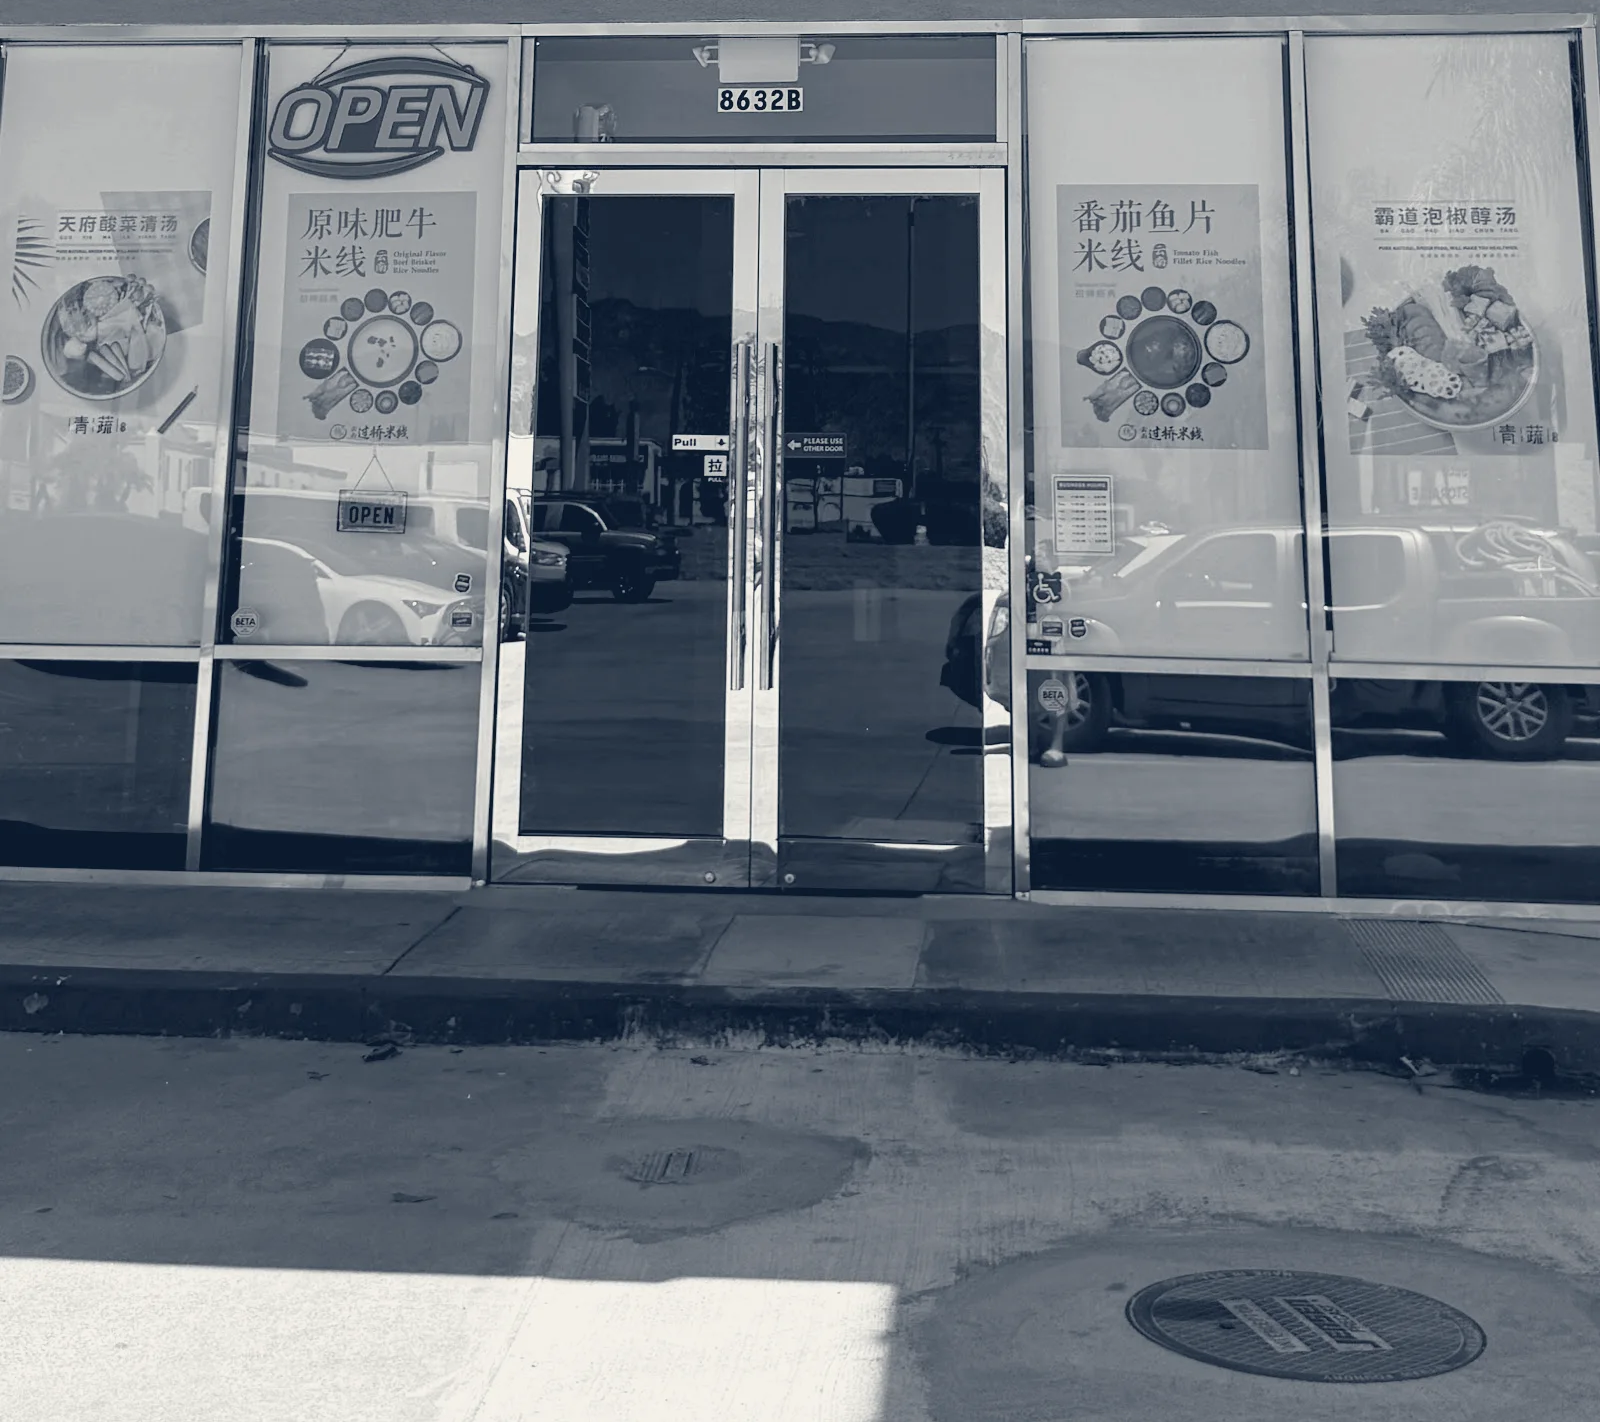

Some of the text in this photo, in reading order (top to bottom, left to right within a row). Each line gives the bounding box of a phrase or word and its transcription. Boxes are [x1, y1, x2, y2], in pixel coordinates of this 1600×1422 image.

[719, 89, 801, 111] 8632B
[269, 85, 488, 155] OPEN
[58, 215, 178, 233] 天府酸菜清汤
[300, 207, 437, 240] 原味肥牛
[1072, 199, 1216, 234] 番茄鱼片
[1374, 207, 1517, 226] 霸道泡椒醇汤
[298, 245, 367, 278] 米线
[393, 250, 423, 259] Original
[1072, 238, 1145, 273] 米线
[1173, 249, 1219, 257] Tomato Fish
[674, 438, 697, 447] Pull
[803, 437, 828, 445] PLEASE
[708, 458, 723, 473] 拉
[349, 506, 394, 525] OPEN
[235, 616, 256, 627] BETA
[1042, 690, 1065, 700] BETA
